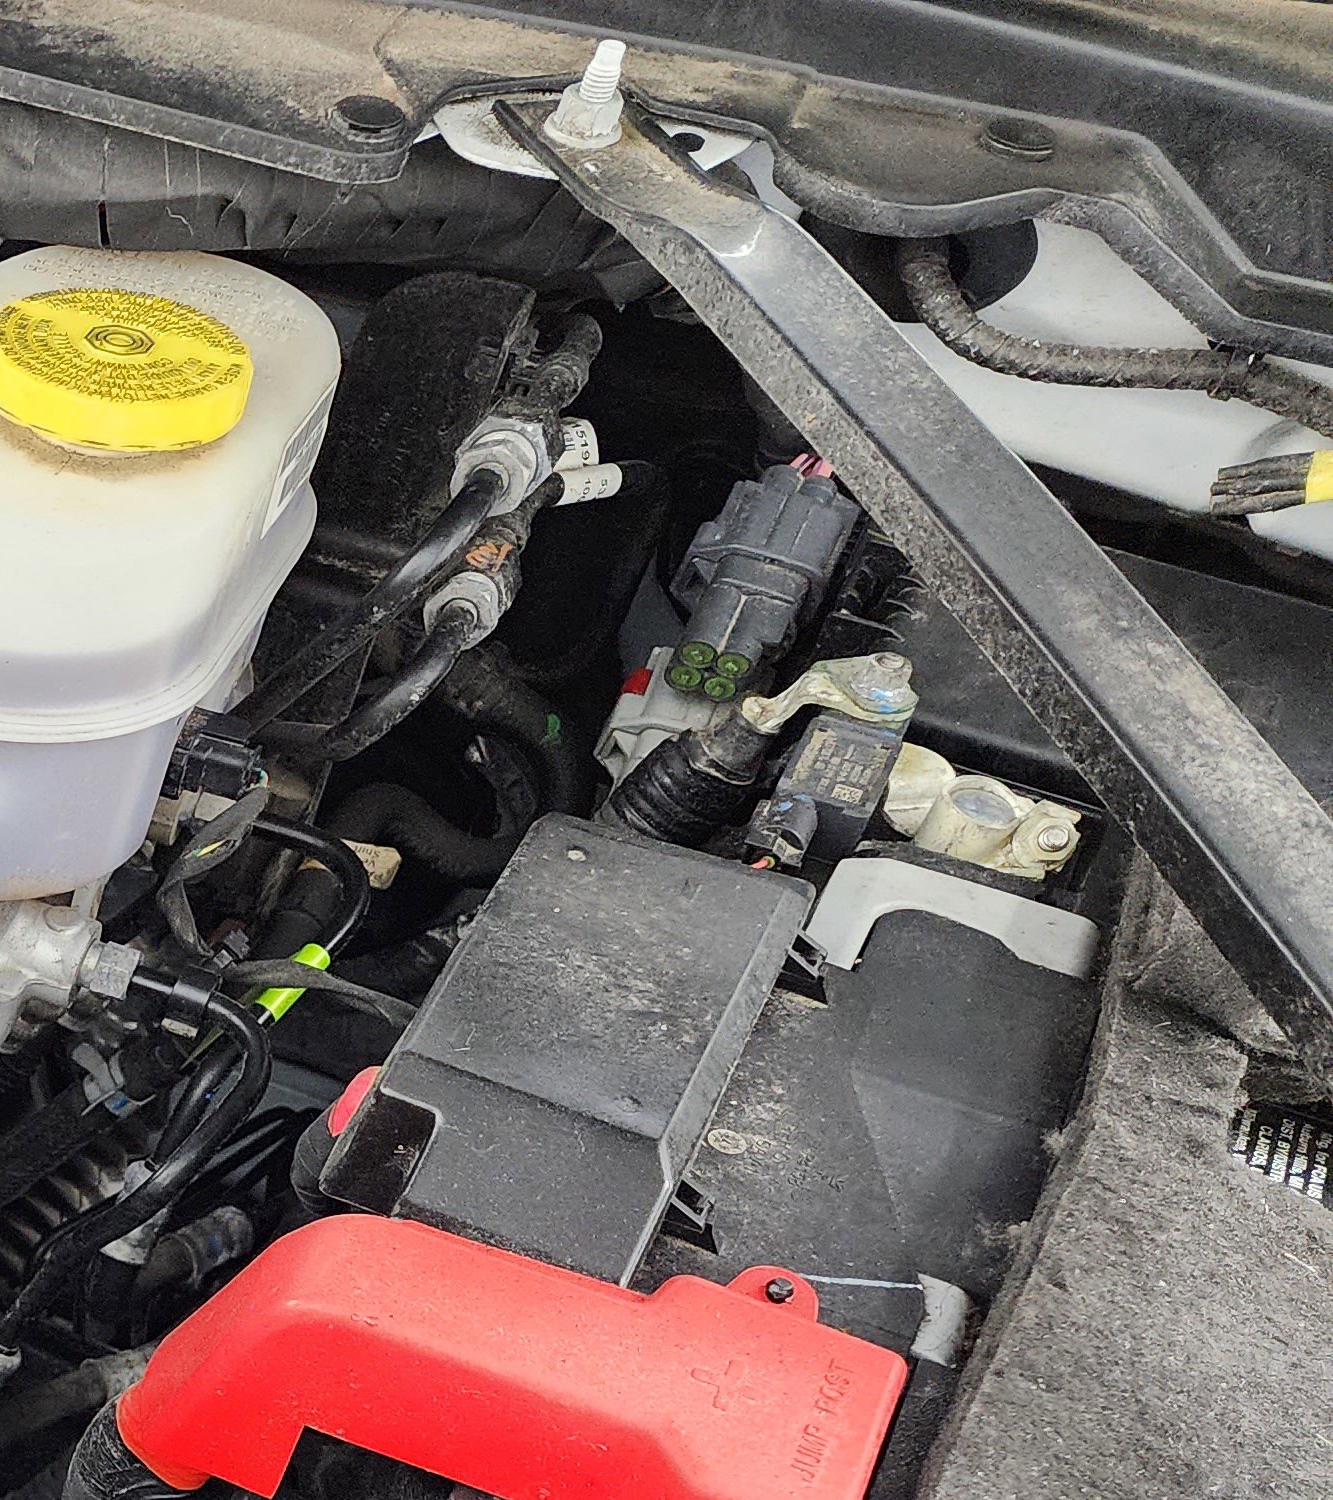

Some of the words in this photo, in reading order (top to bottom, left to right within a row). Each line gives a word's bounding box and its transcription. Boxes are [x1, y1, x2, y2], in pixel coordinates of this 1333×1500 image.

[1278, 1118, 1295, 1141] DIST.
[789, 1423, 830, 1484] JUMP
[813, 1357, 854, 1416] POST
